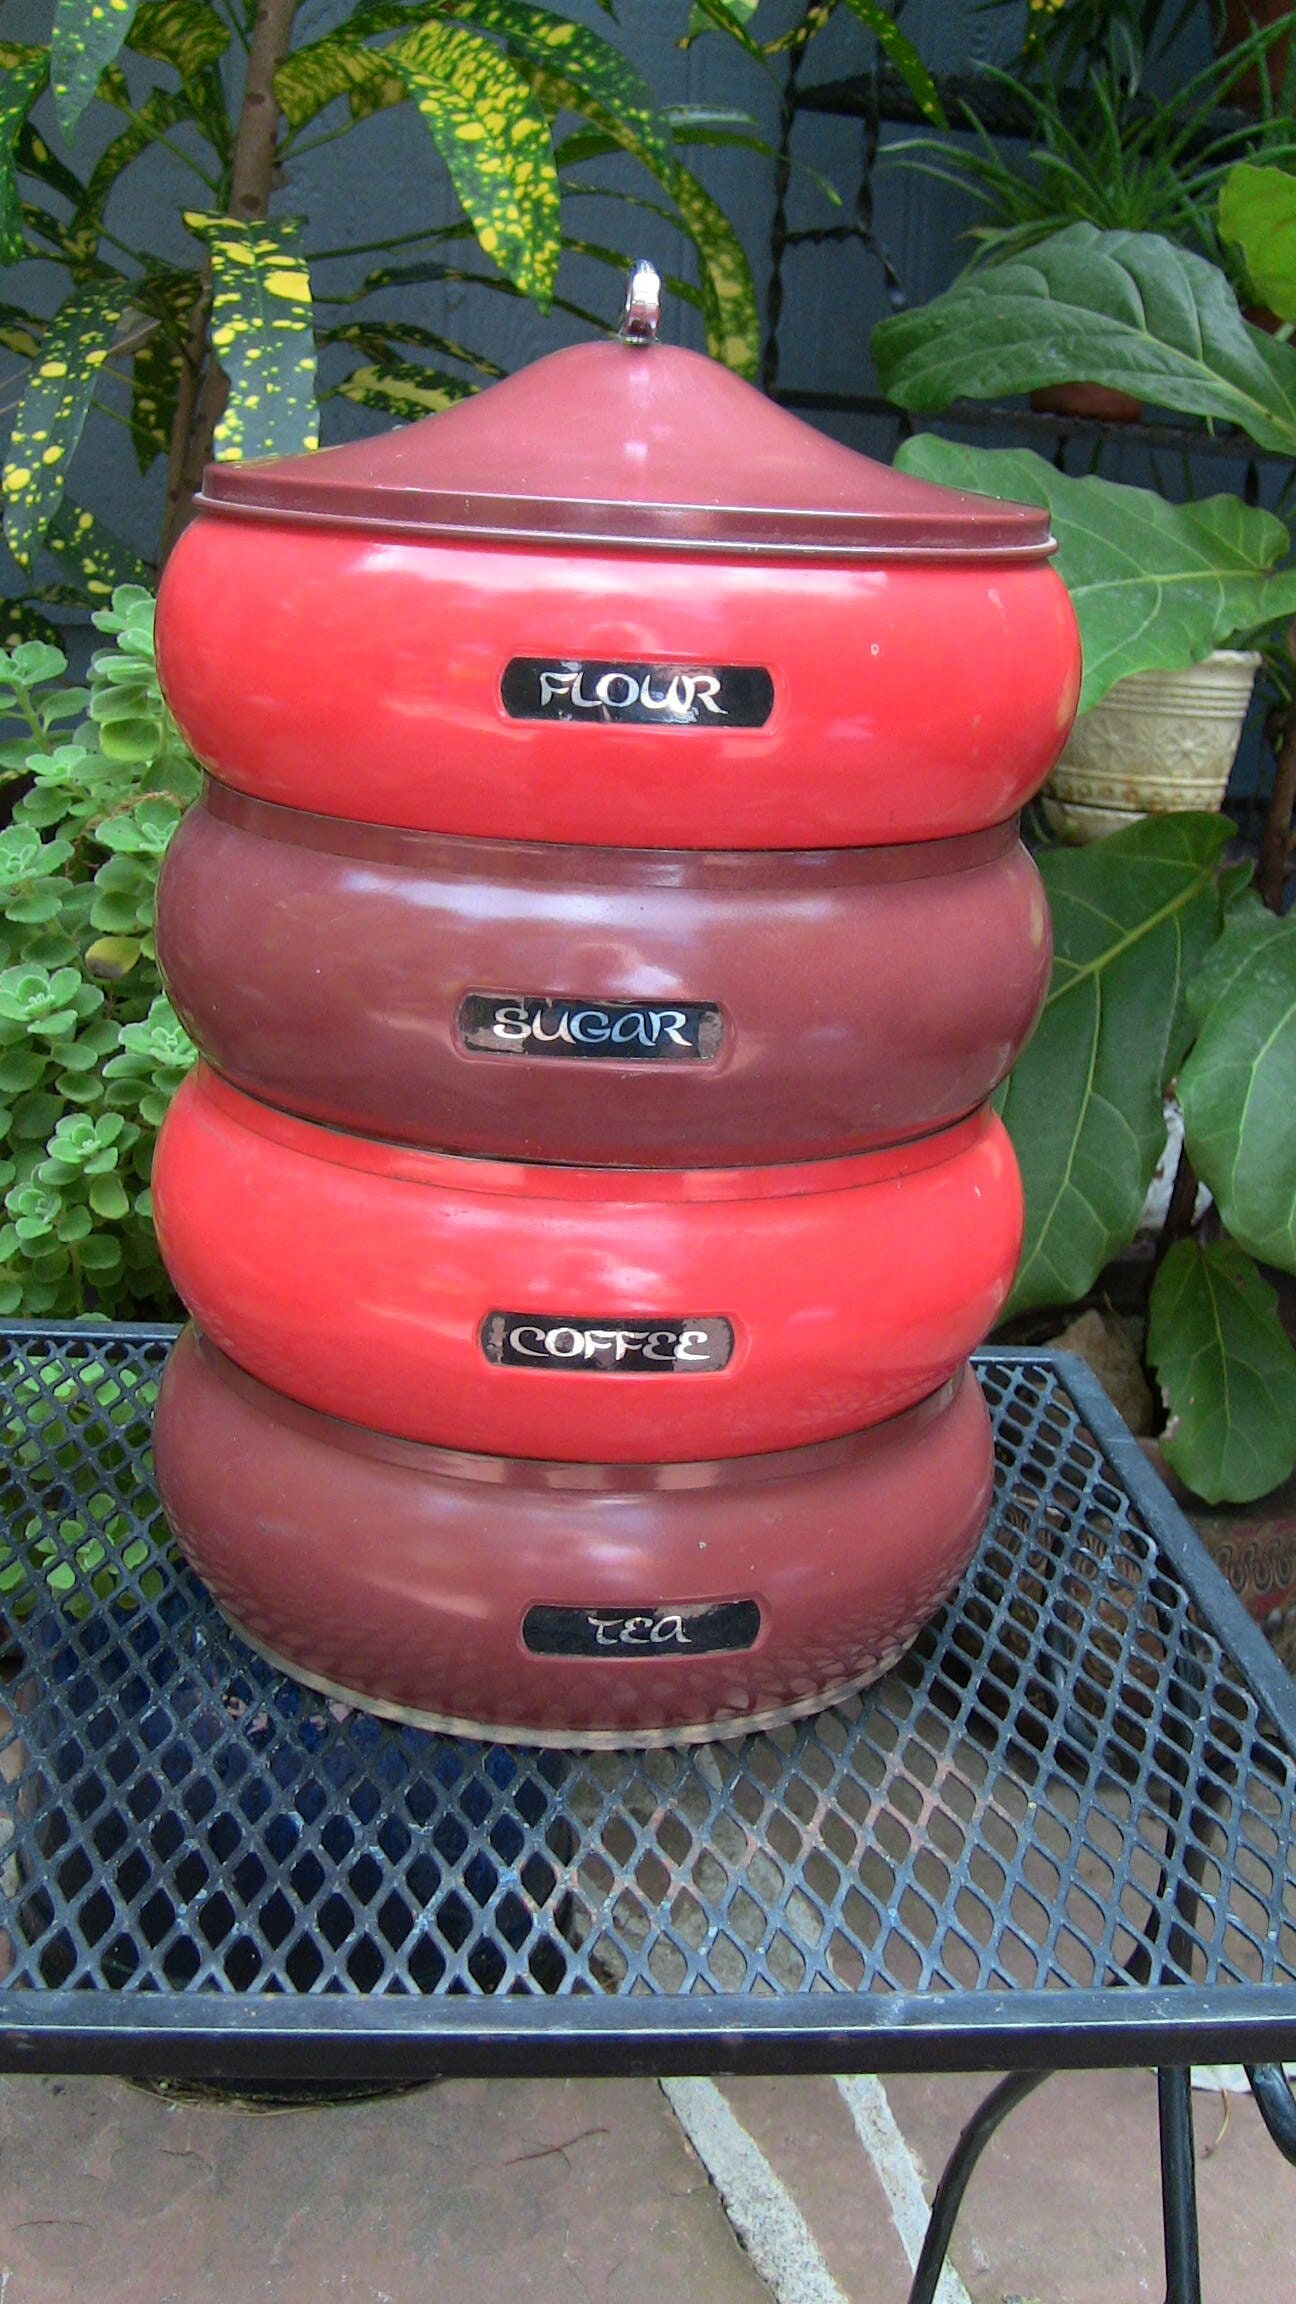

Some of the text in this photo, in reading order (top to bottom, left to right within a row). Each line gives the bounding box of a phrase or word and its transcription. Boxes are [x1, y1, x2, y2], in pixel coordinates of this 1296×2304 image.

[540, 672, 728, 715] FLOUR
[493, 1007, 693, 1047] SUGAR
[509, 1326, 710, 1361] COFFEE
[588, 1615, 692, 1645] TEA
